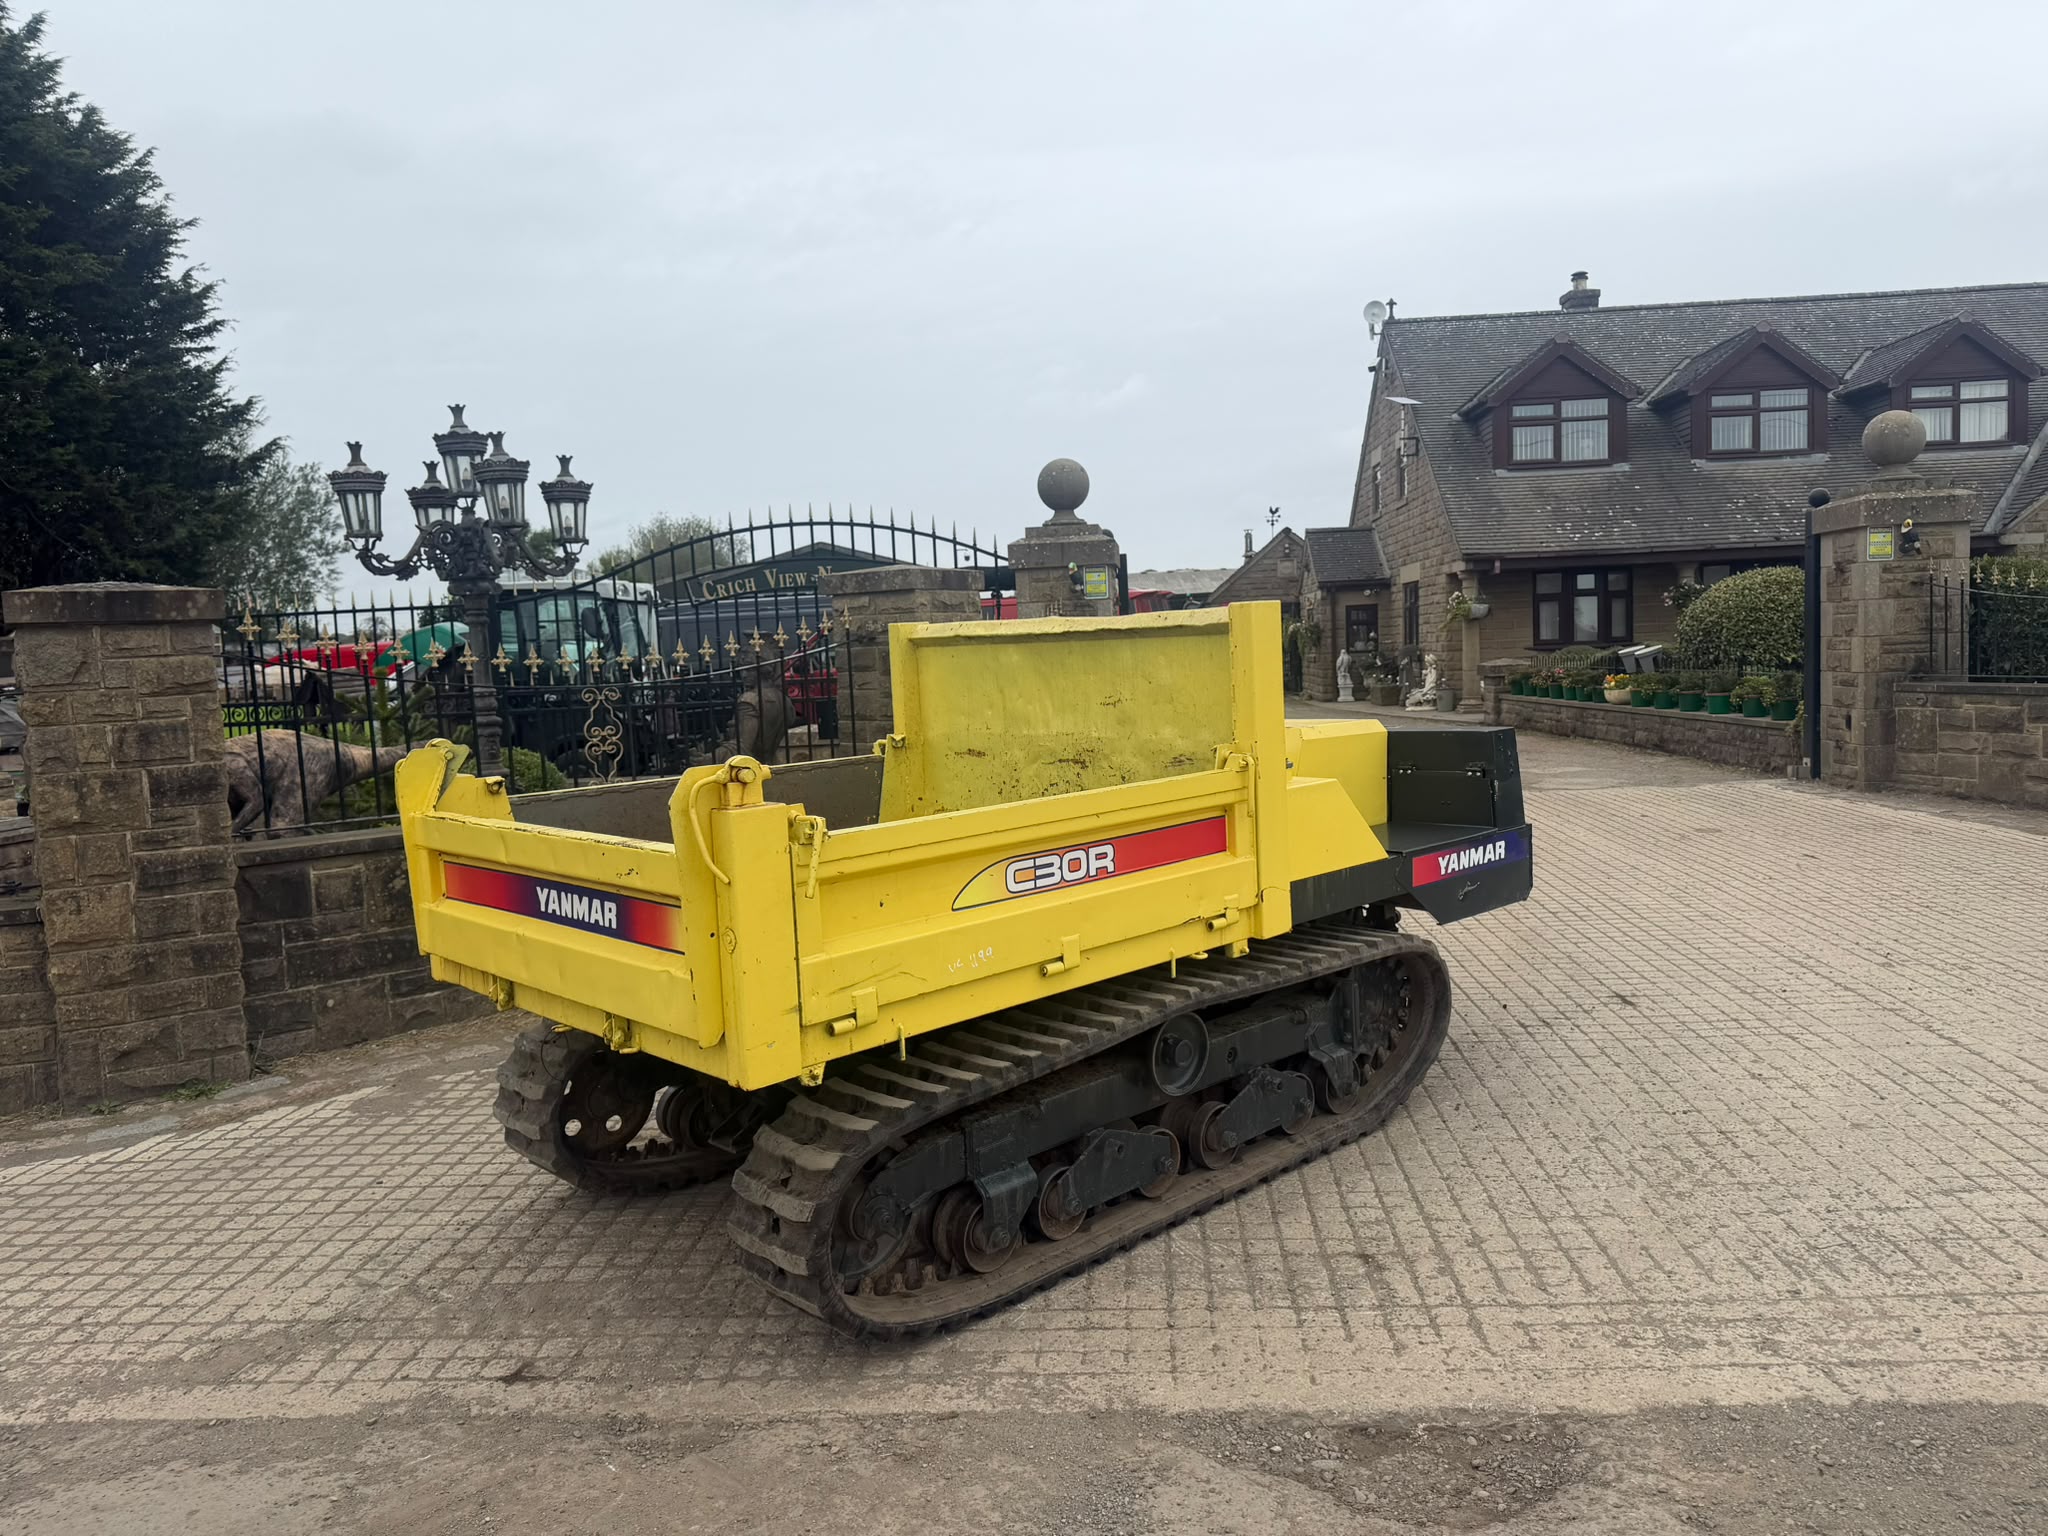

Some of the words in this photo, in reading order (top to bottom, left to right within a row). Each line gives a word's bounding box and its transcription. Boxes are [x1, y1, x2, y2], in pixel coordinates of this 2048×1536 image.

[702, 577, 757, 600] CRICH
[764, 568, 808, 589] VIEW
[1438, 841, 1505, 875] YANMAR
[536, 886, 617, 929] YANMAR
